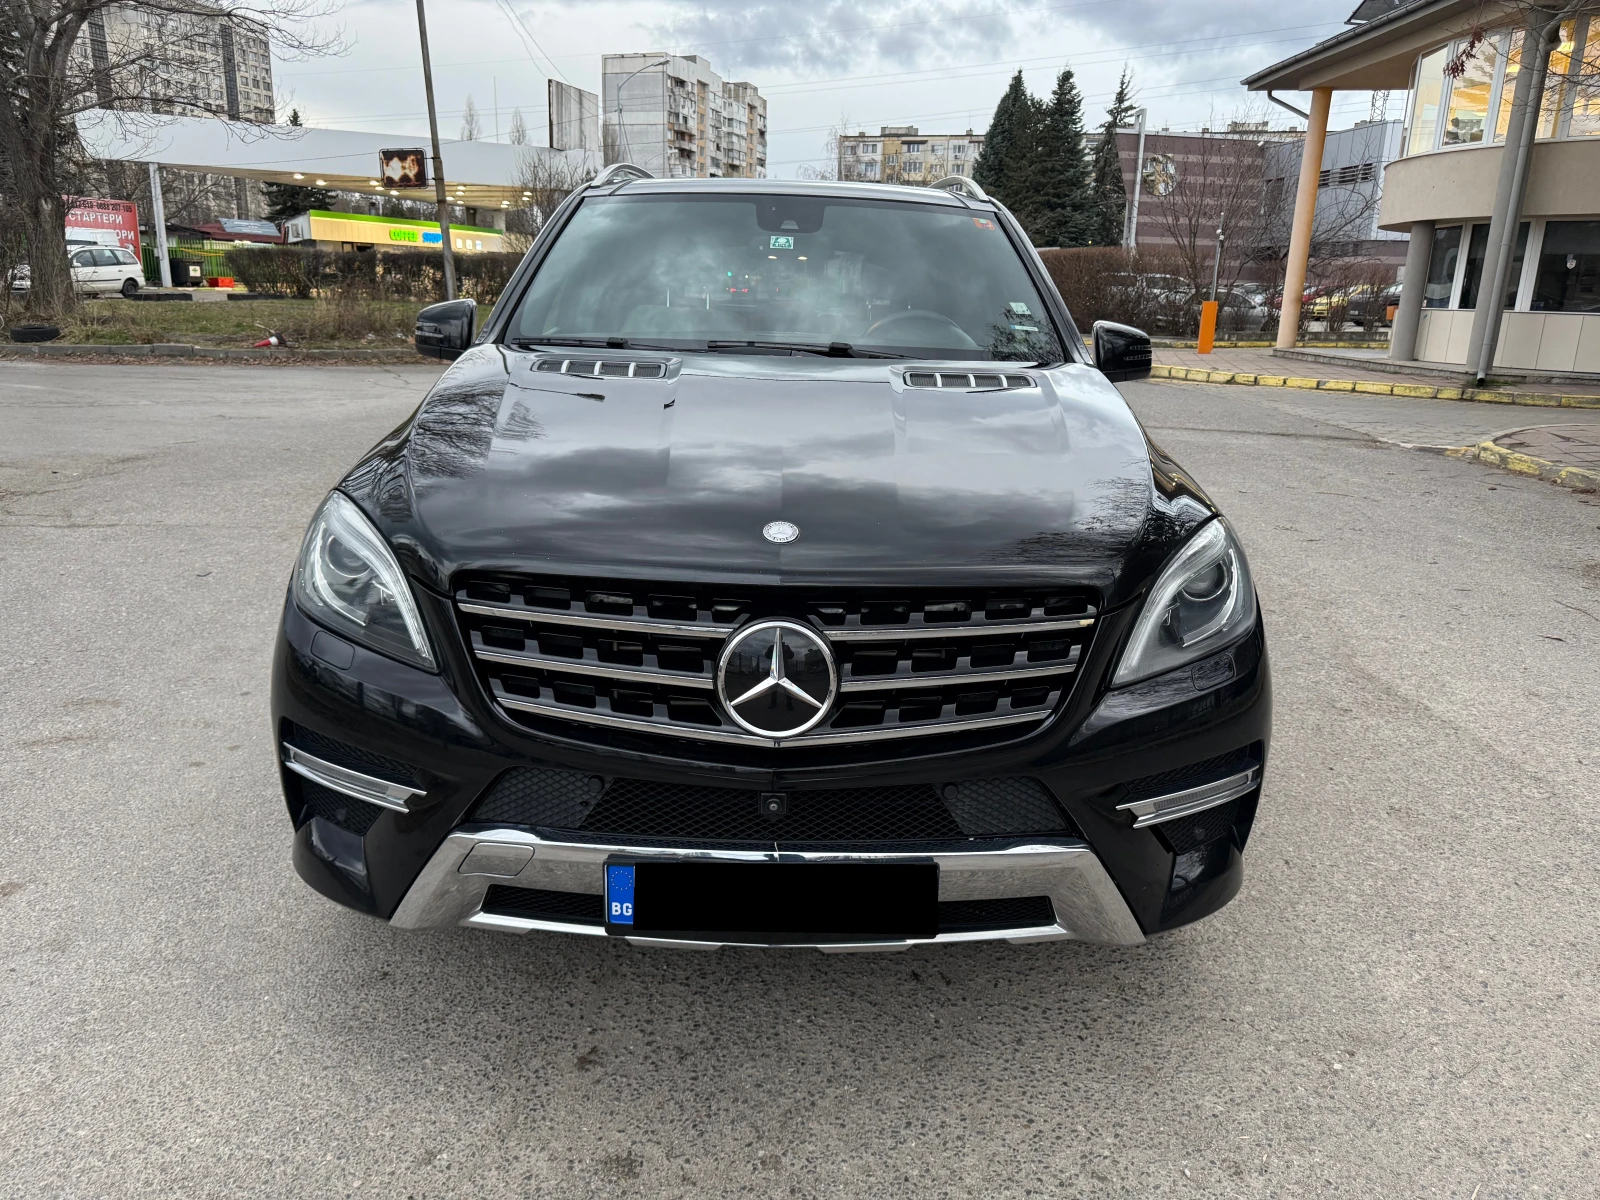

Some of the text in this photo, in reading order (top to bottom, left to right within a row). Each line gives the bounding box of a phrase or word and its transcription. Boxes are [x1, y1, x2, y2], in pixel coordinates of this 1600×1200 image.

[69, 211, 123, 224] СТАРТЕРИ
[115, 230, 135, 240] ОРИ
[389, 229, 418, 242] COFFEE
[611, 901, 633, 916] BG
